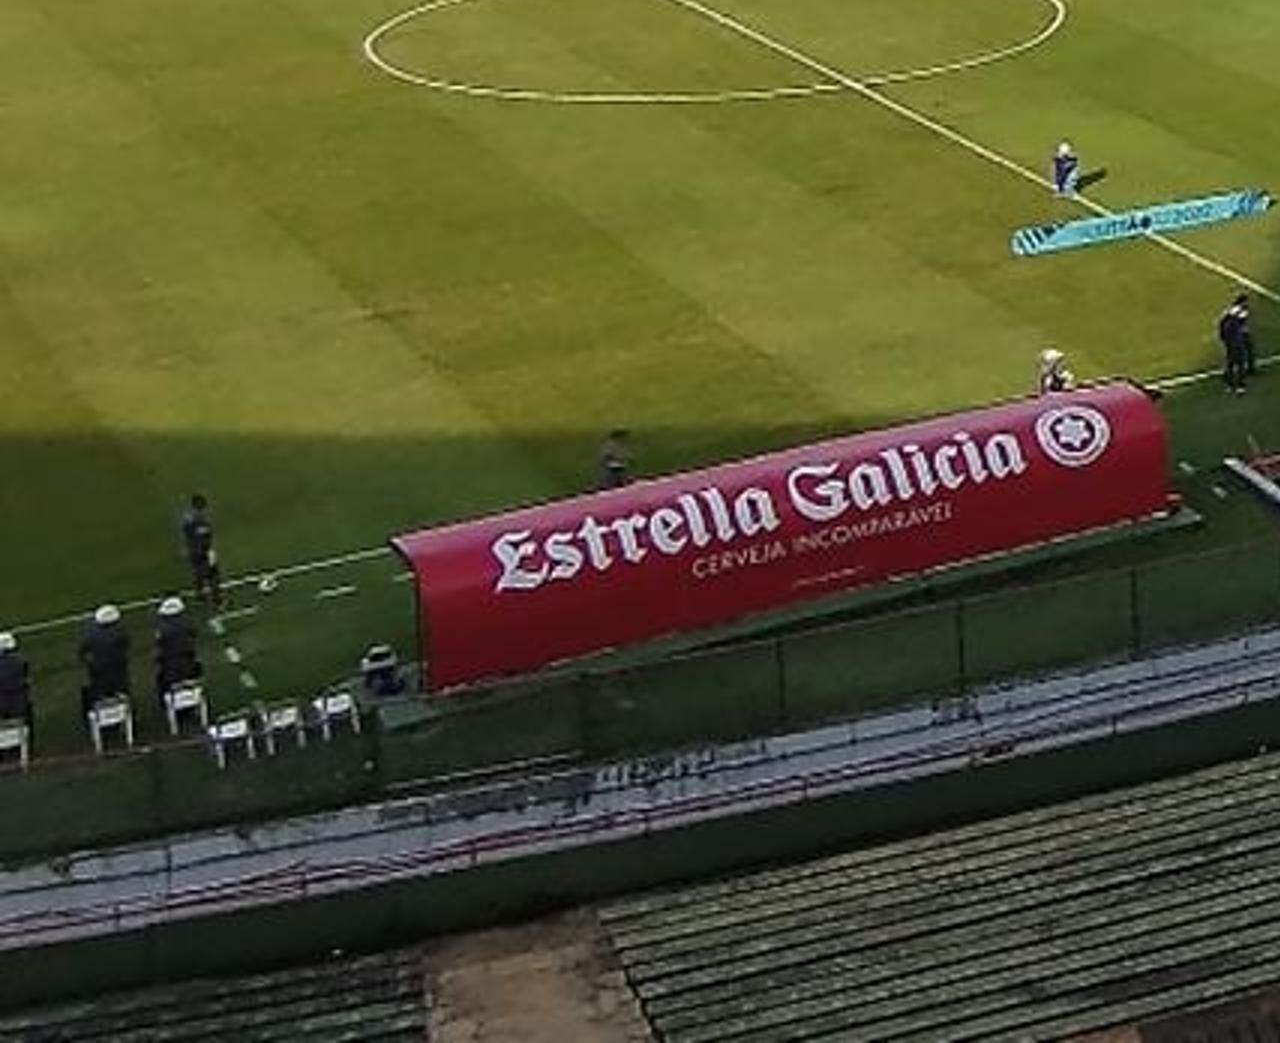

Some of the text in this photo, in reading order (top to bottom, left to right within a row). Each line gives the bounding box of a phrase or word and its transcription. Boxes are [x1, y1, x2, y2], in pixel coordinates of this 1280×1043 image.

[491, 429, 1028, 595] Estrella Galicia
[691, 539, 786, 579] CERVEJA
